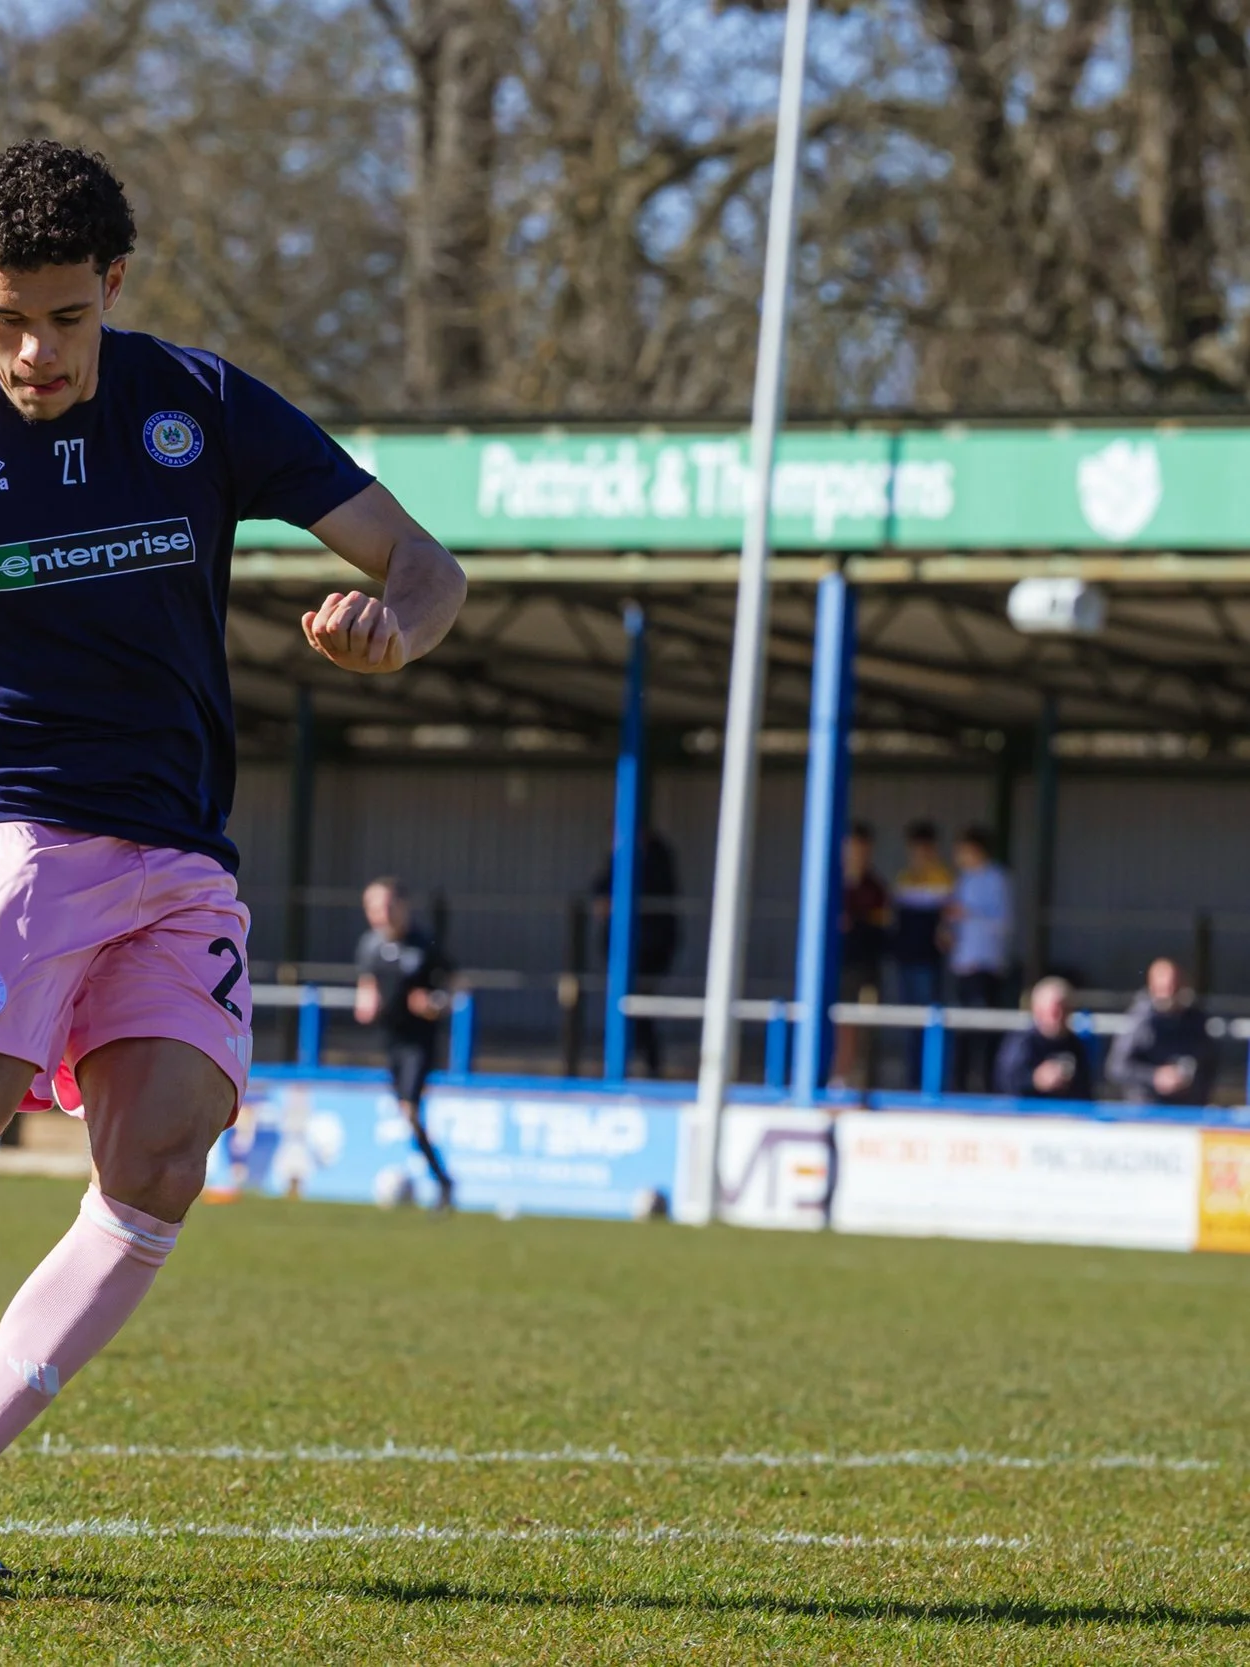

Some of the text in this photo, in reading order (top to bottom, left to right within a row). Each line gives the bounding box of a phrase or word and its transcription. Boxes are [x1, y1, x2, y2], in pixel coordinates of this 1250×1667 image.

[145, 413, 197, 435] CURZON ASHTON
[54, 438, 87, 485] 27
[150, 440, 201, 465] FOOTBALL CLUB
[650, 446, 689, 518] &
[690, 440, 954, 540] Thmpsons
[0, 531, 191, 578] enterprise
[208, 936, 247, 1023] 2
